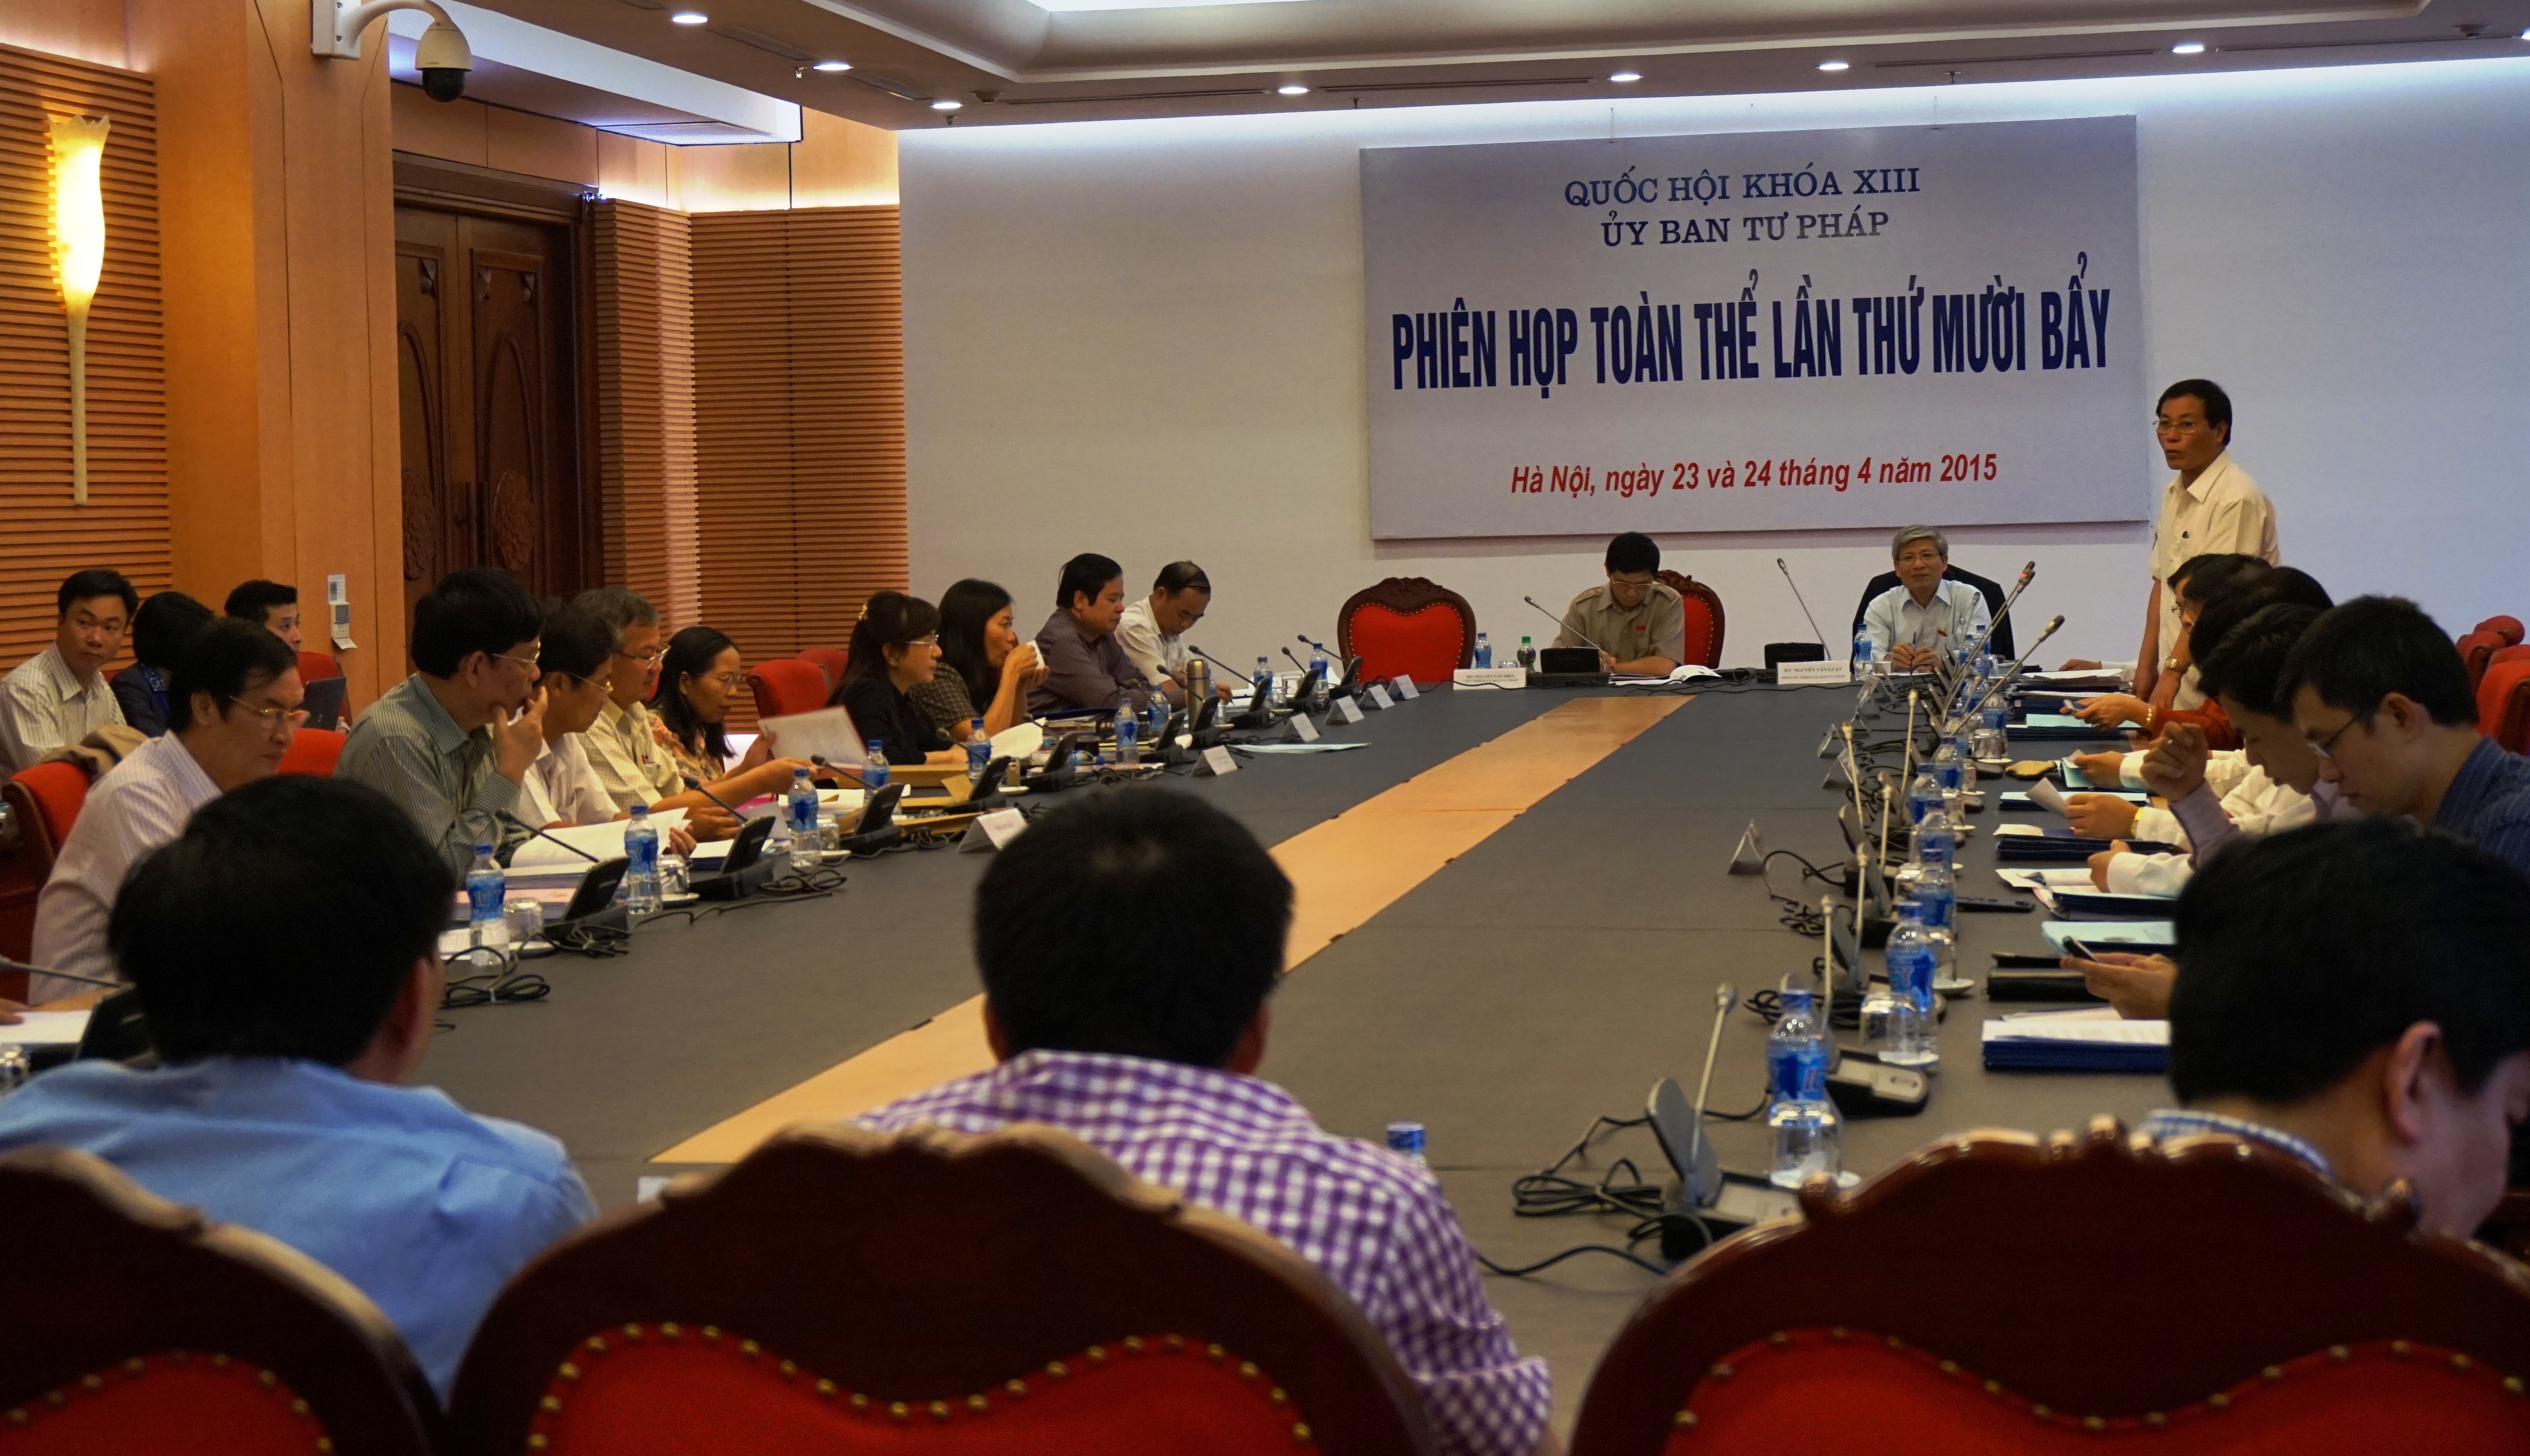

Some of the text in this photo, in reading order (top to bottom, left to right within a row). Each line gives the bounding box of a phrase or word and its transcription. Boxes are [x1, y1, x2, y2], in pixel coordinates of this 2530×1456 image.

[1565, 162, 1921, 208] QUỐC HỘI KHÓA XIII
[1601, 205, 1889, 247] ỦY BAN TƯ PHÁP
[1393, 252, 2111, 400] PHIÊN HỌP TOÀN THỂ LẦN THỨ MƯỜI BẨY
[1511, 454, 1998, 499] Hà Nội, ngày 23 và 24 tháng 4 năm 2015
